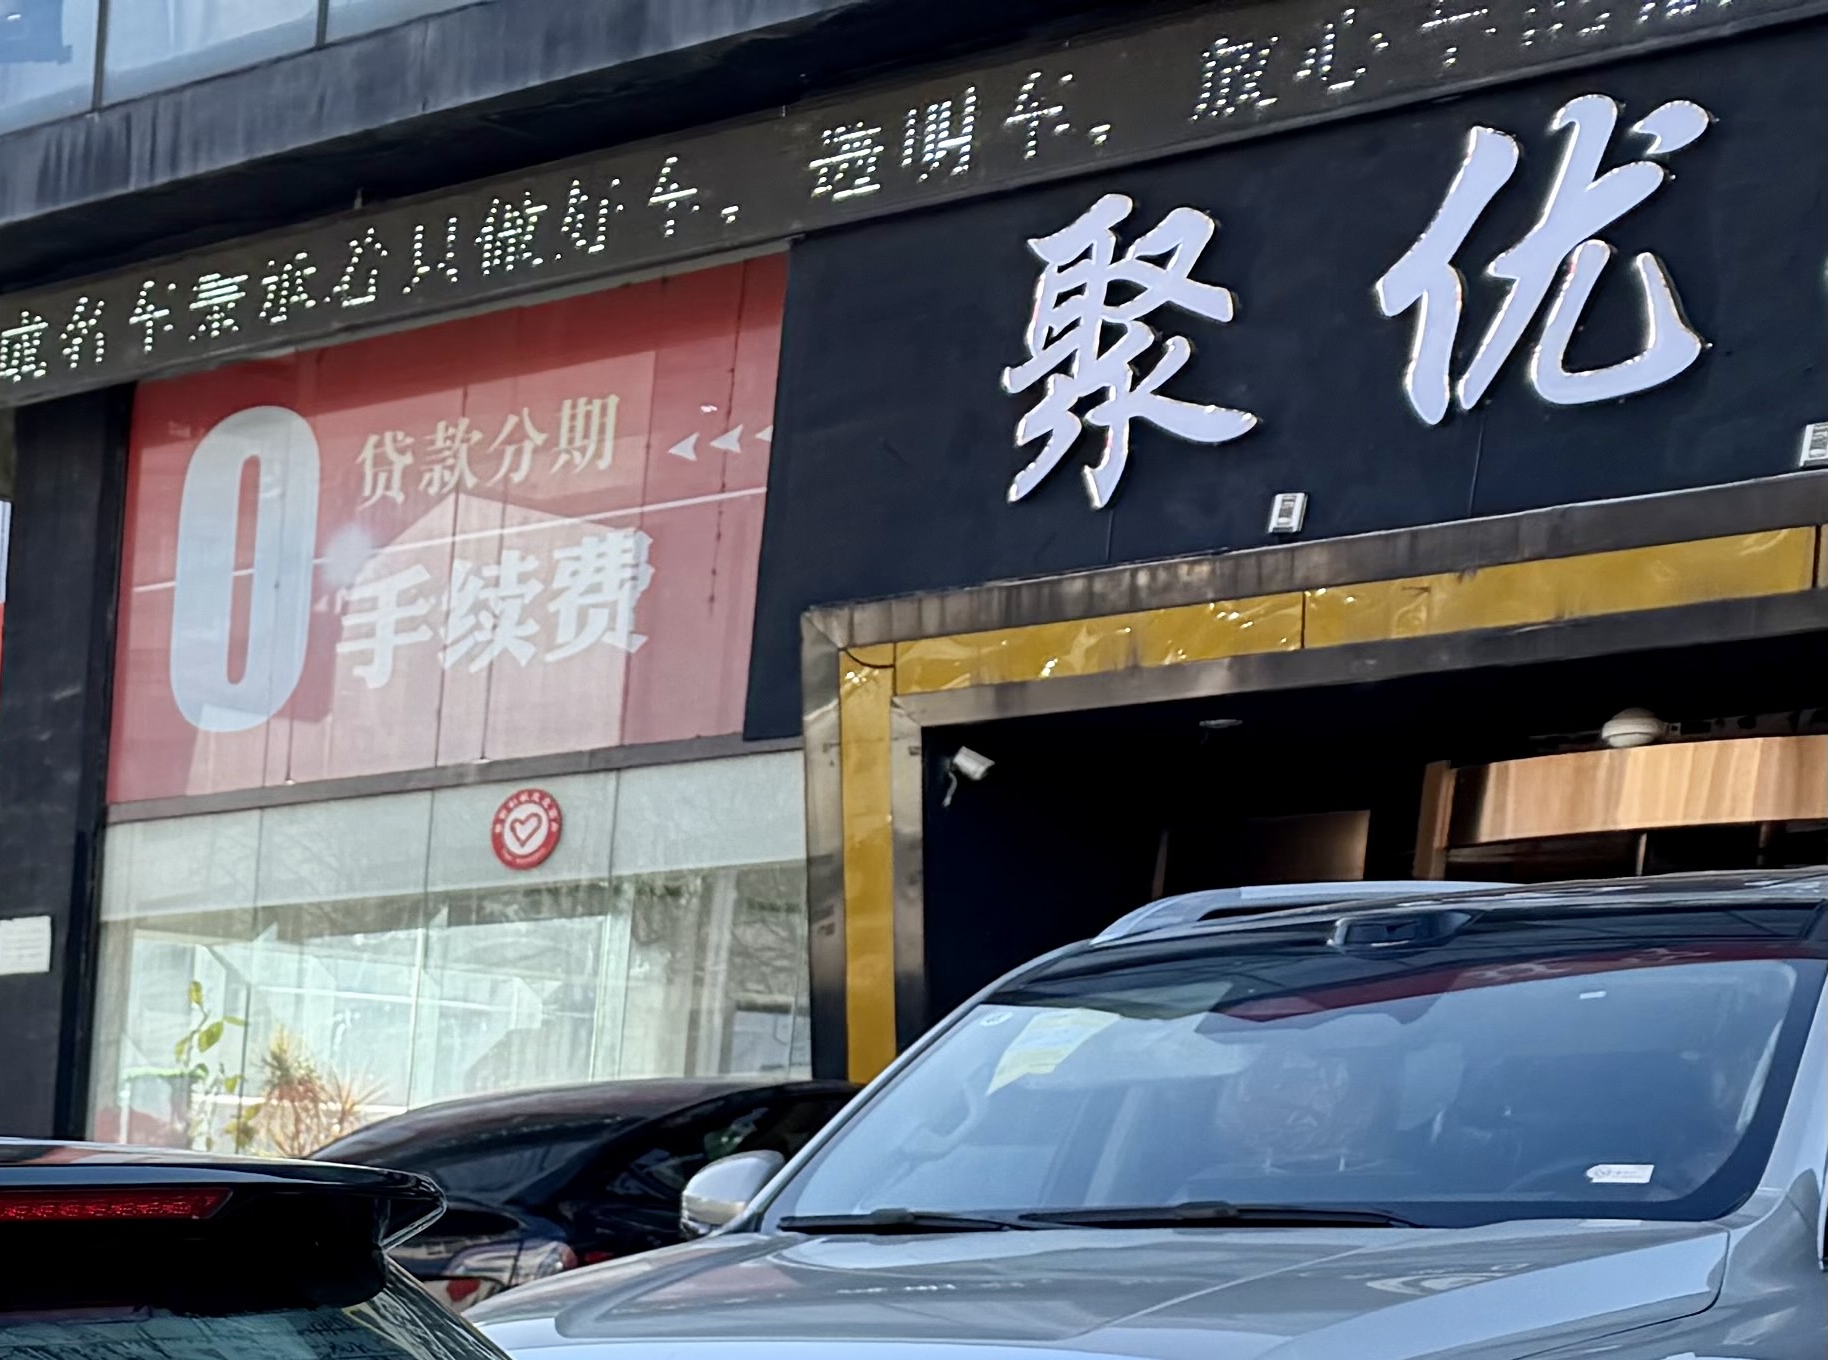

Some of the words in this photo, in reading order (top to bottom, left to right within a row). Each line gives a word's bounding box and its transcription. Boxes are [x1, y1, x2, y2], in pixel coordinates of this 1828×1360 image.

[1000, 93, 1712, 510] 聚优
[169, 404, 321, 732] 0
[356, 395, 620, 509] 贷款分期
[335, 528, 655, 690] 手续费
